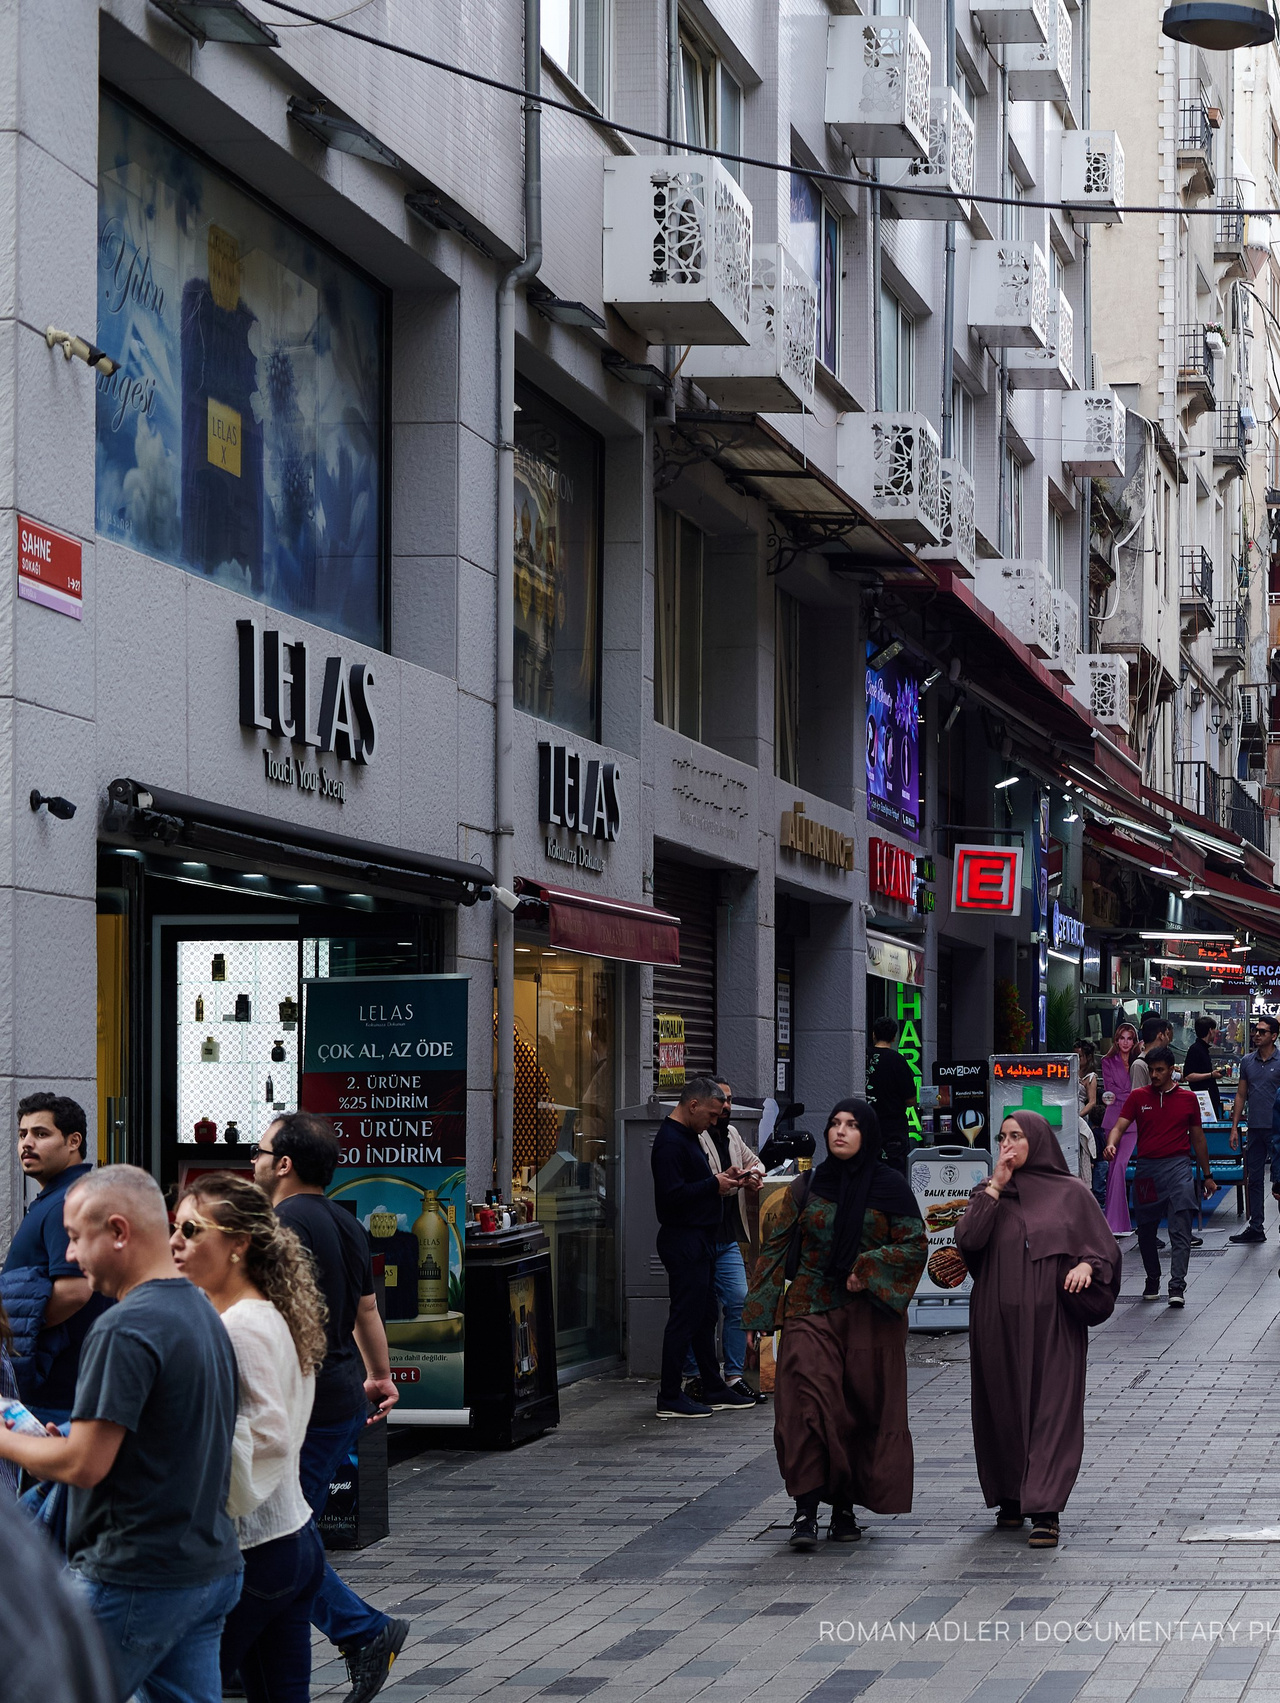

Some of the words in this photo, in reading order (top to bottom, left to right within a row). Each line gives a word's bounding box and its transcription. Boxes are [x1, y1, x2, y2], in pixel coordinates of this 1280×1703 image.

[212, 416, 237, 446] LELAS
[21, 530, 52, 563] SAHNE
[22, 557, 41, 576] SOKAĞI
[237, 618, 378, 766] LELAS
[263, 749, 294, 785] Touch
[295, 759, 320, 791] Your
[538, 741, 620, 842] LELAS
[968, 858, 1005, 901] E
[359, 1003, 414, 1021] LELAS
[317, 1044, 355, 1062] ÇOK
[358, 1043, 385, 1060] AL,
[388, 1043, 412, 1058] AZ
[416, 1039, 454, 1058] ÖDE
[347, 1076, 360, 1090] 2.
[367, 1074, 422, 1090] ÜRÜNE
[338, 1096, 367, 1110] %25
[371, 1093, 429, 1110] İNDİRİM
[333, 1121, 350, 1138] 3.
[360, 1118, 434, 1138] ÜRÜNE
[337, 1147, 361, 1165] 50
[366, 1143, 443, 1164] İNDİRİM
[924, 1189, 946, 1197] BALIK
[419, 1238, 441, 1246] LELAS
[927, 1237, 945, 1246] ALIK
[421, 1354, 449, 1363] değildir.
